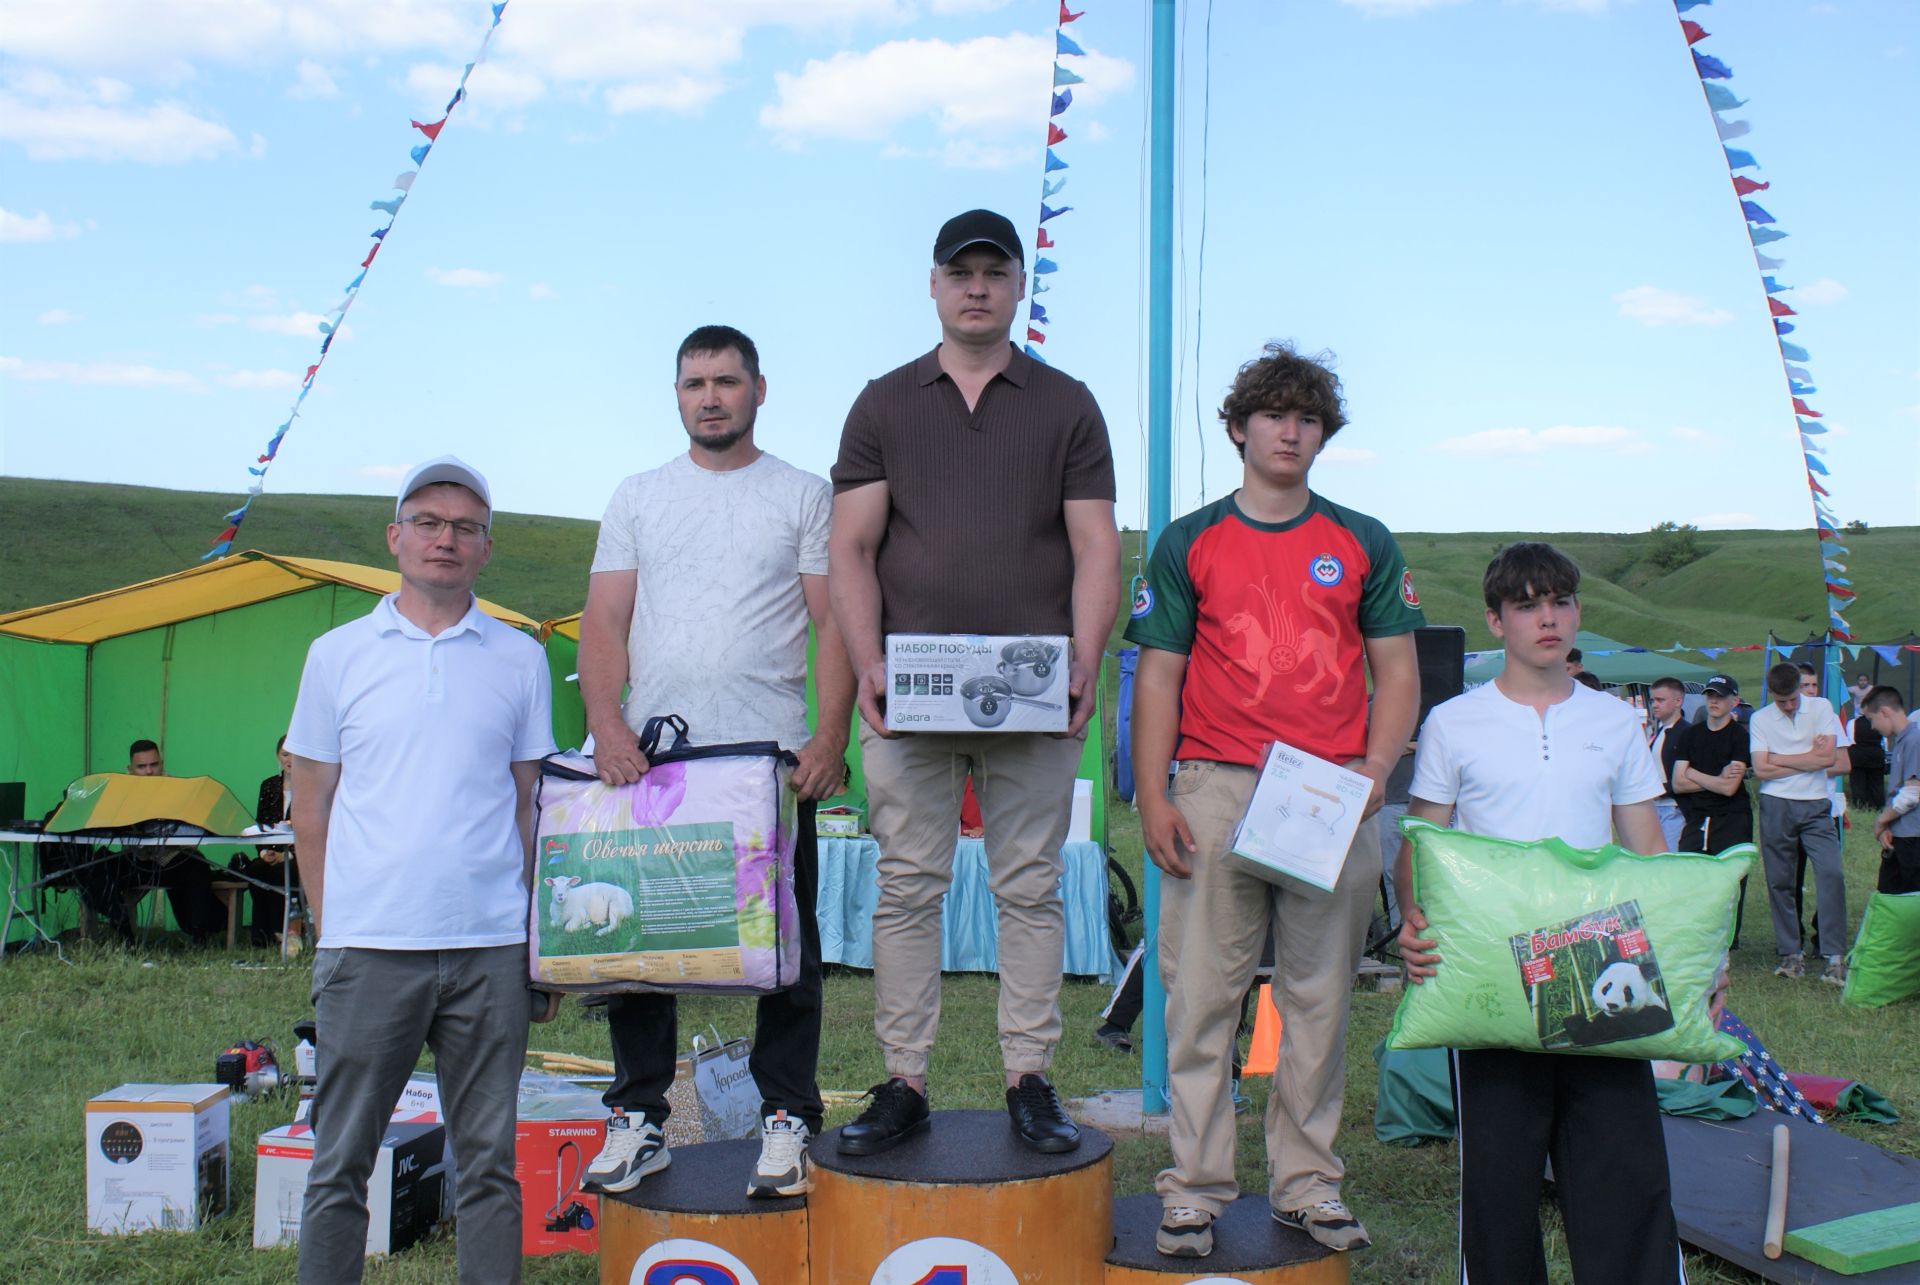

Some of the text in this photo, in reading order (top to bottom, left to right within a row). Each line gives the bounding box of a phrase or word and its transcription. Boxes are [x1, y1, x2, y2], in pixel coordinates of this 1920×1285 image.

[895, 643, 992, 655] НАБОР ПОСУДЫ
[582, 838, 723, 861] Овечья шерсть
[1531, 914, 1622, 954] Бамбук
[406, 1088, 433, 1100] Набор
[548, 1128, 597, 1137] STARWIND
[396, 1154, 419, 1178] JVC
